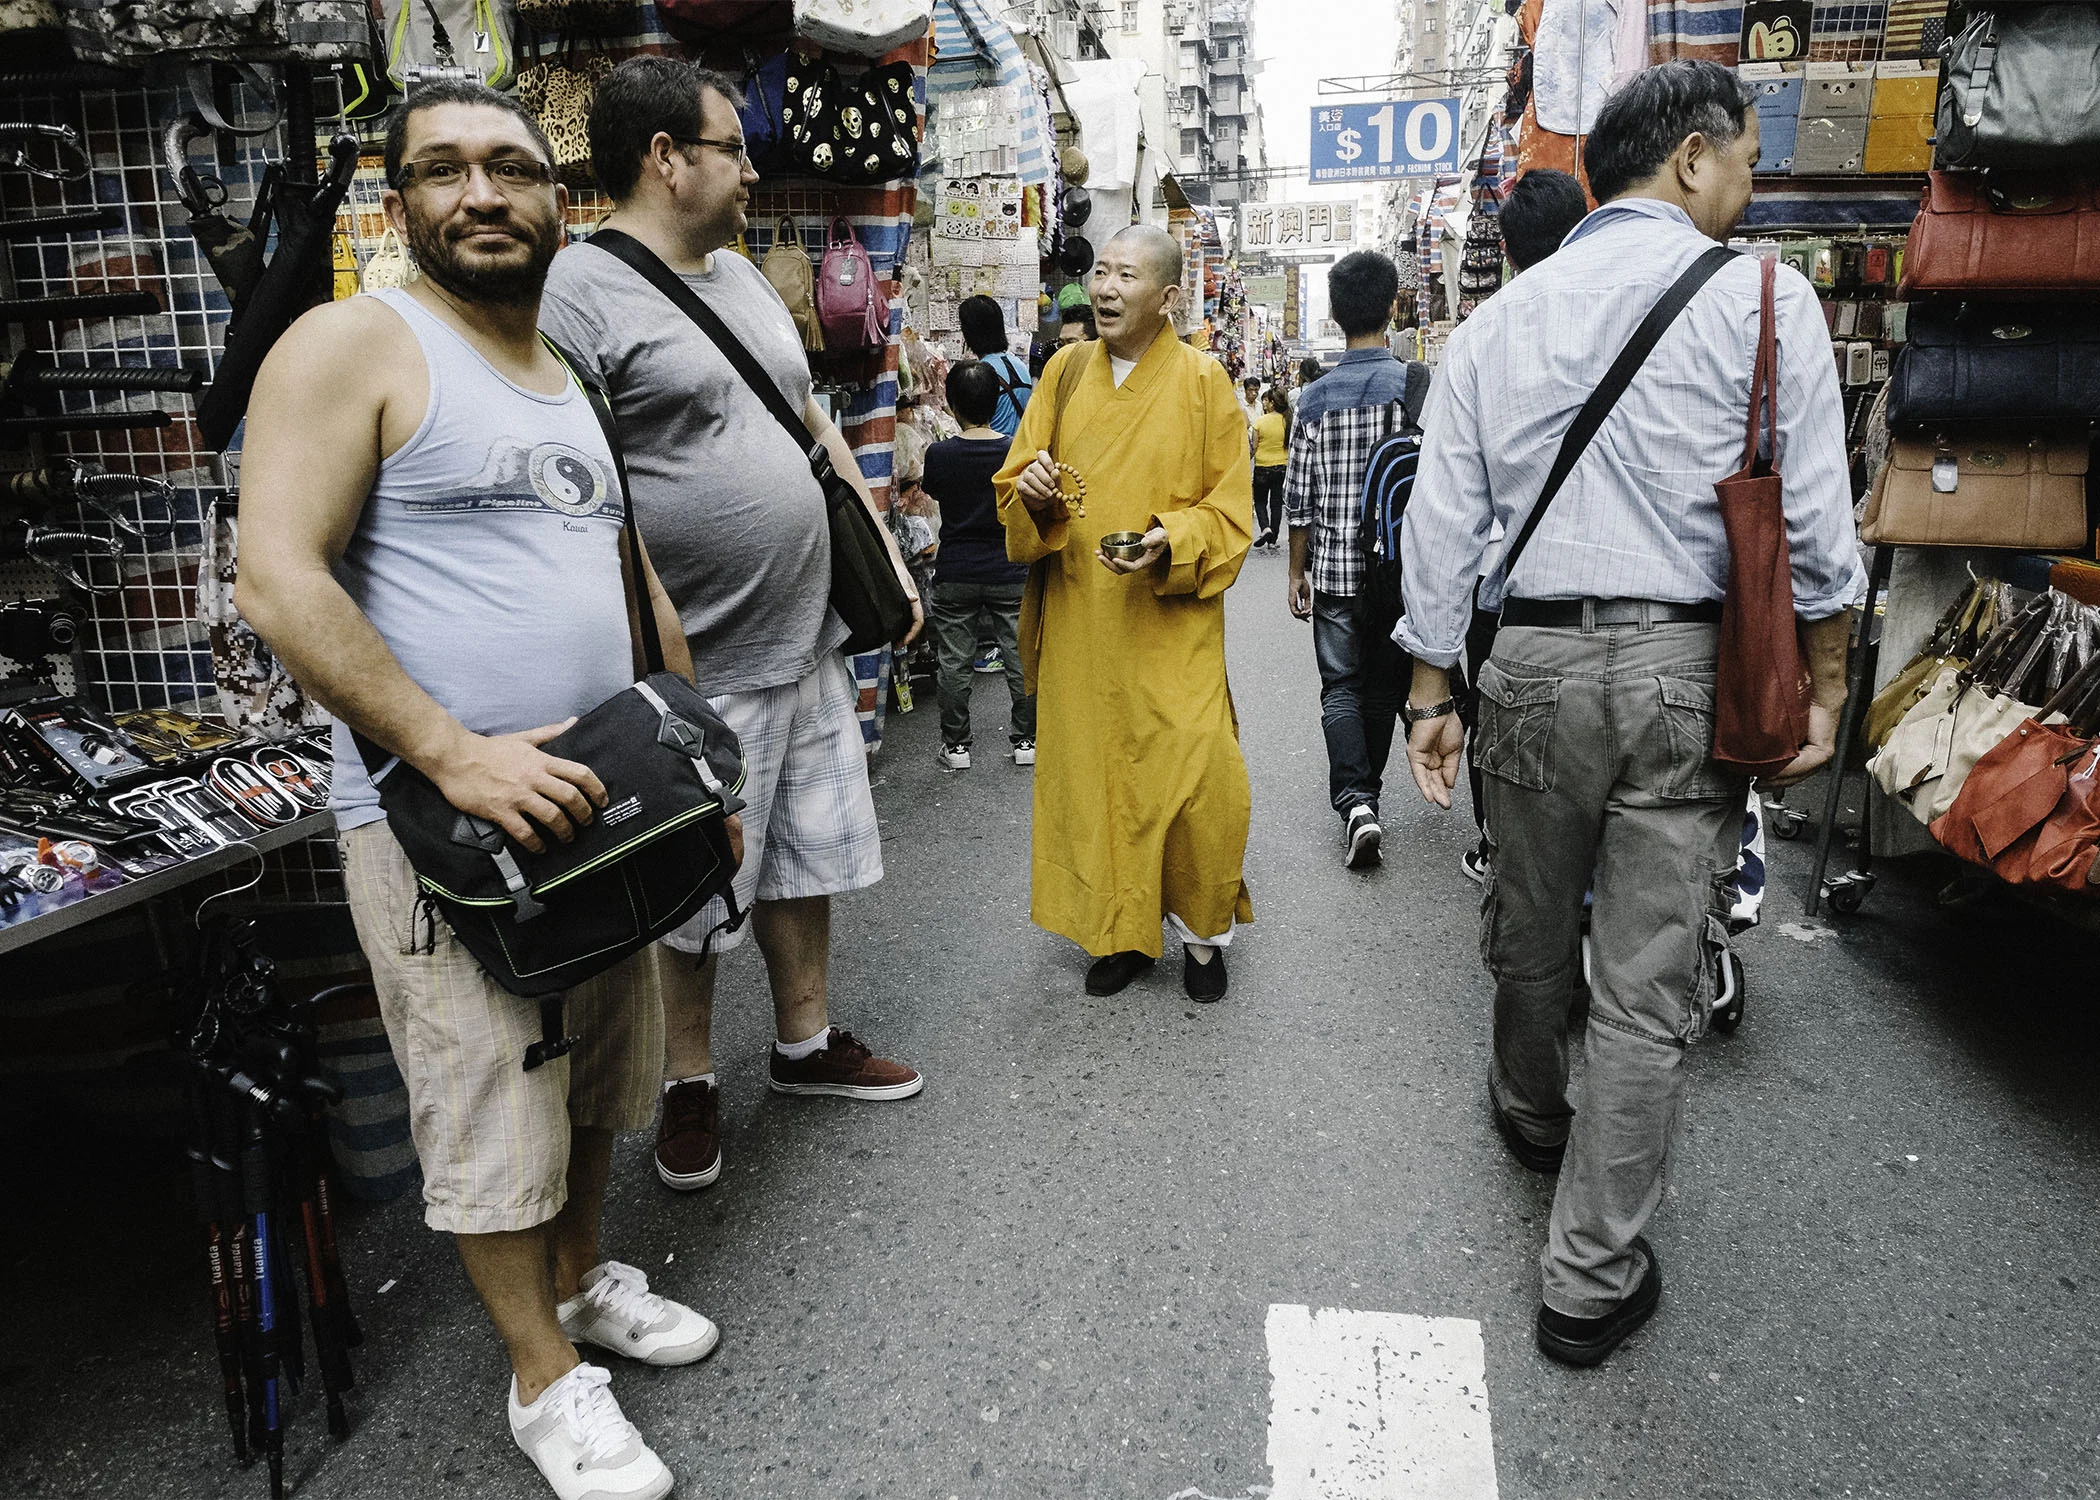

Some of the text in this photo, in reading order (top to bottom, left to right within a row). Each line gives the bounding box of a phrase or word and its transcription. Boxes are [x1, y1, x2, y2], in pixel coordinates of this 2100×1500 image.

[1336, 102, 1452, 164] $10
[1407, 163, 1432, 174] FASHION
[1434, 161, 1453, 172] STOCK
[1247, 204, 1332, 245] 新澳門
[478, 499, 543, 509] Pipeline
[563, 521, 589, 533] Kauai
[209, 1245, 223, 1285] Yuanda
[253, 1238, 265, 1280] Yuanda
